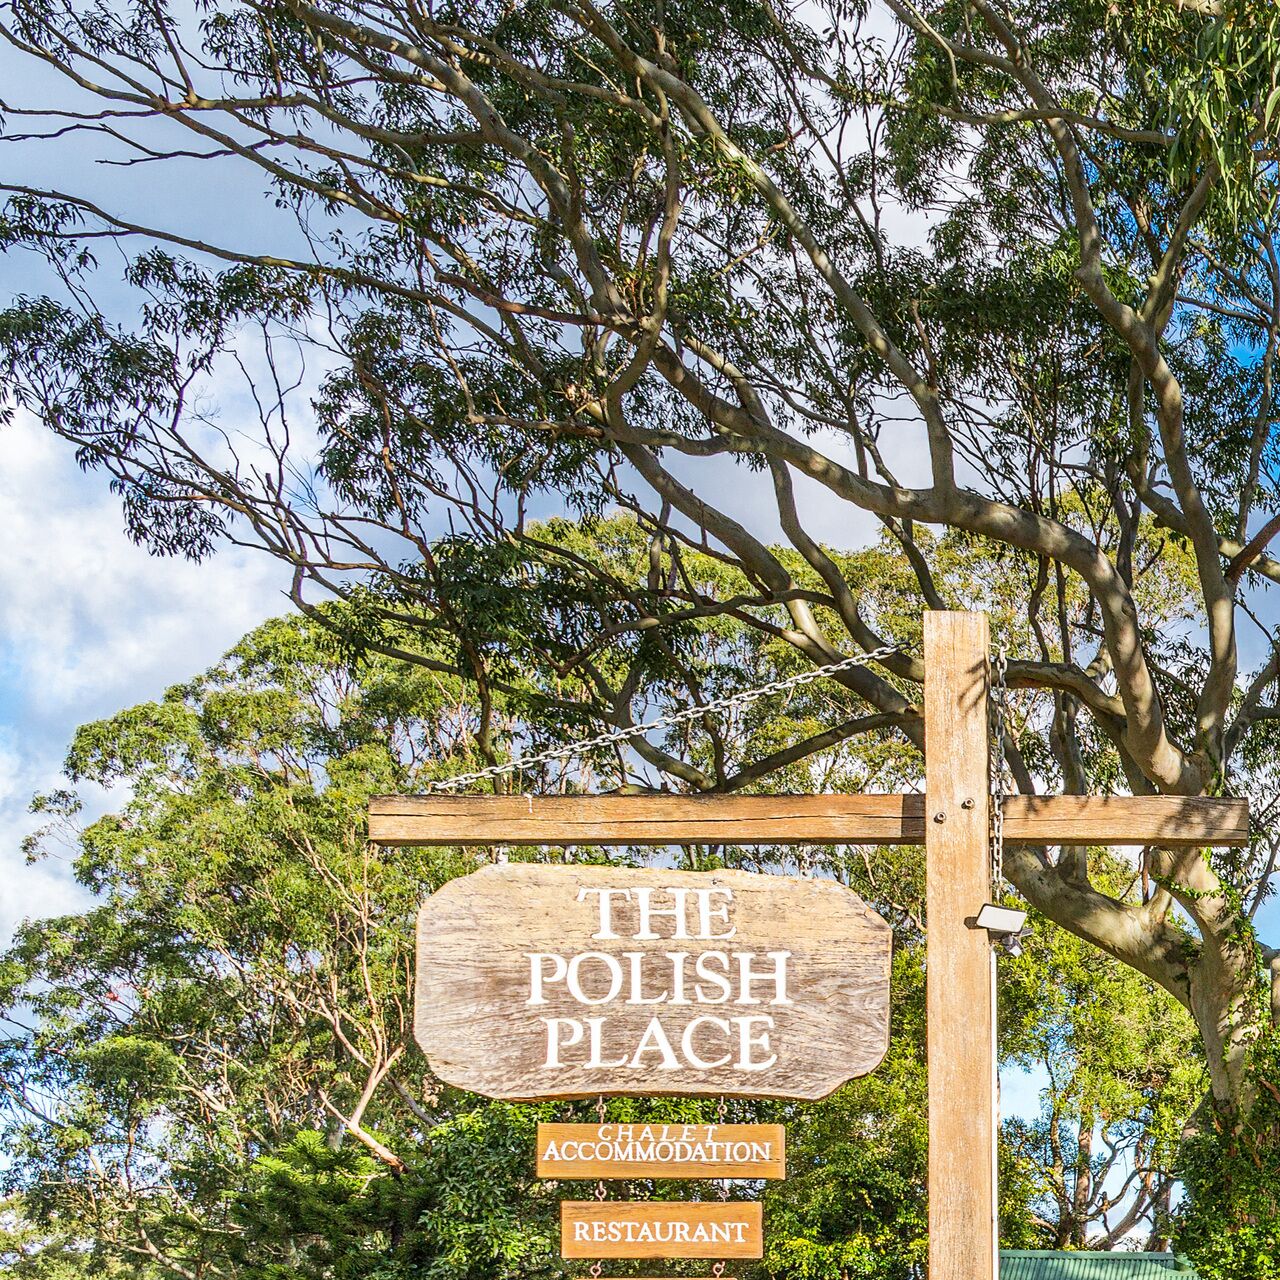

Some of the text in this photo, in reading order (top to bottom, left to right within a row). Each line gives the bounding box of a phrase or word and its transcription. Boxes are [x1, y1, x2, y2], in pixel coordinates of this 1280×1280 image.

[578, 887, 737, 940] THE
[526, 951, 792, 1005] POLISH
[541, 1017, 778, 1070] PLACE
[543, 1140, 771, 1162] ACCOMMODATION
[598, 1126, 718, 1141] CHALET
[574, 1222, 749, 1242] RESTAURANT
